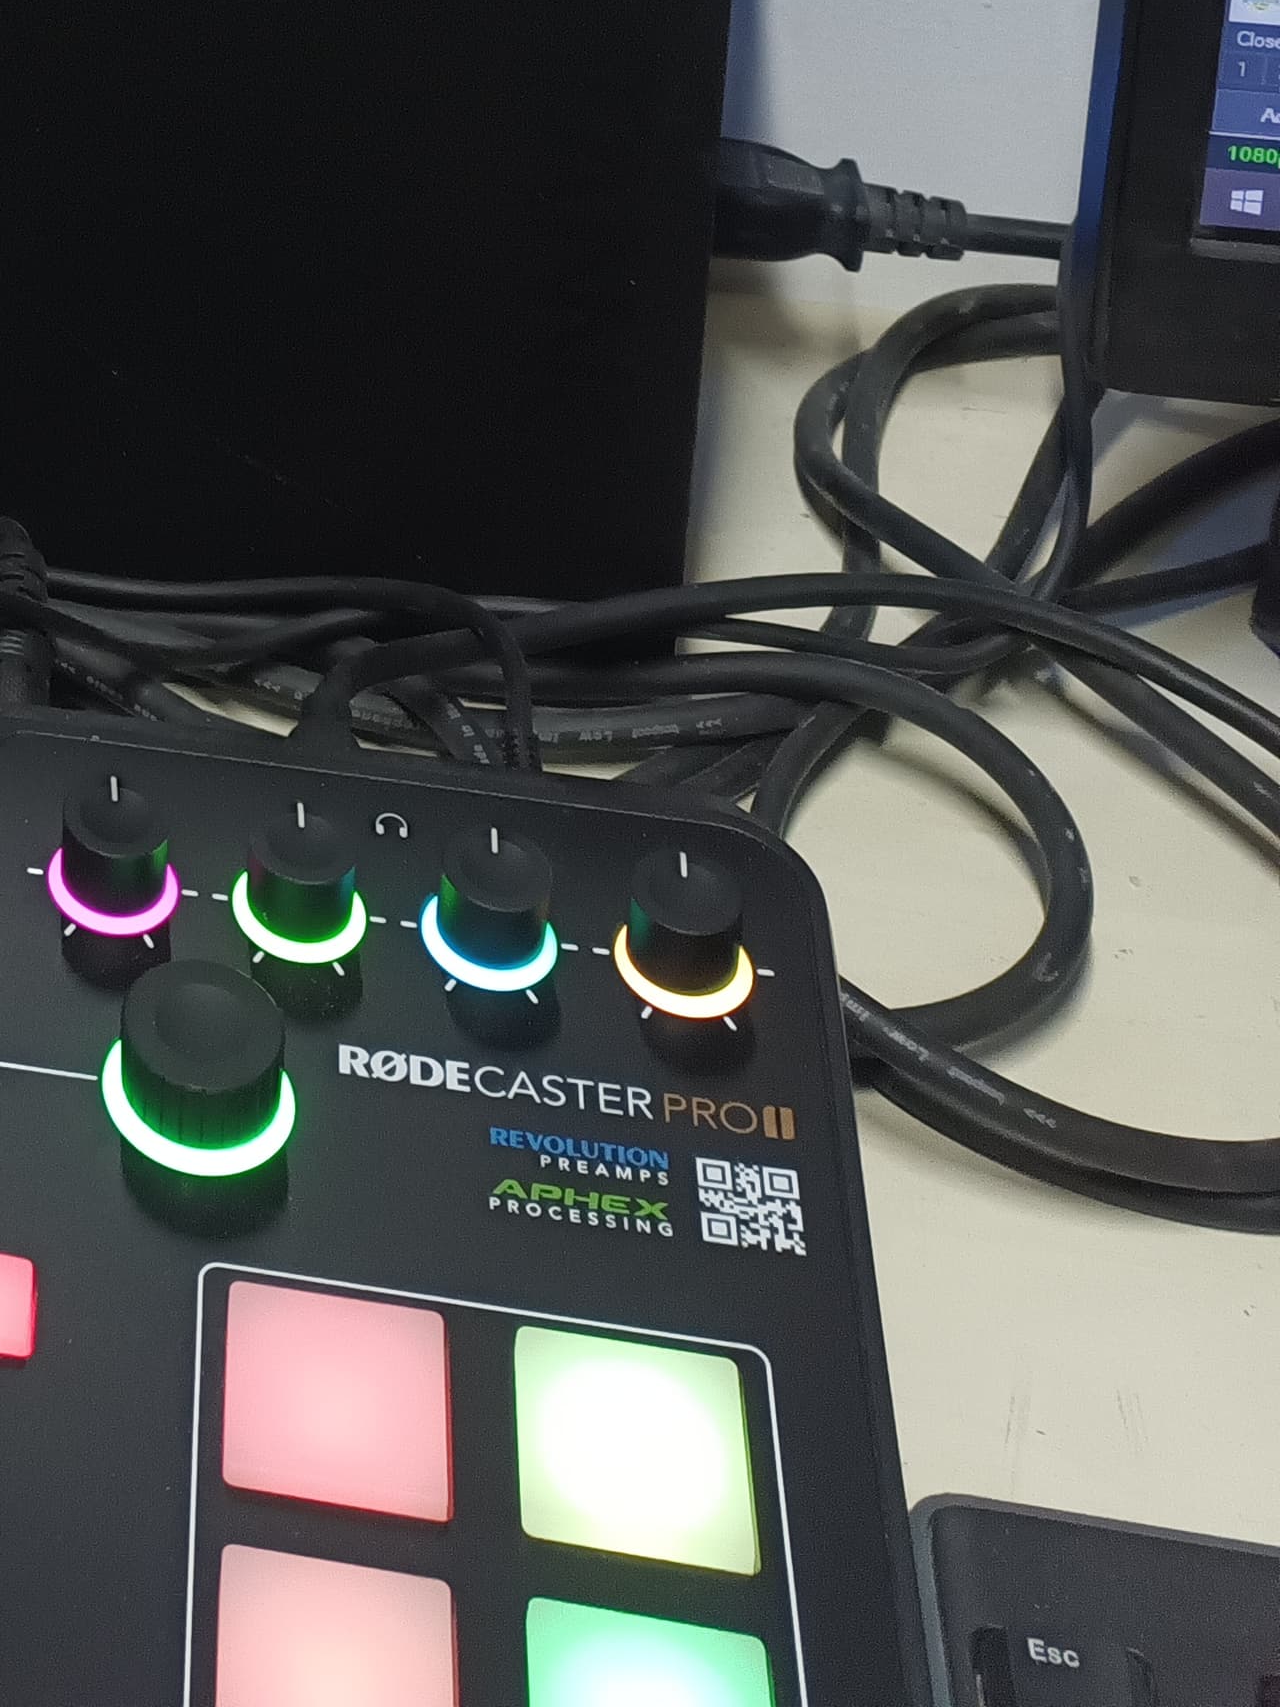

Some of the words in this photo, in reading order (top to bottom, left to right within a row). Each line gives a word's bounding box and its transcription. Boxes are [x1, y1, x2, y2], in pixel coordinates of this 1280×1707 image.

[488, 1125, 670, 1171] REVOLUTION
[539, 1153, 671, 1188] PREAMPS
[487, 1196, 675, 1239] PROCESSING
[491, 1177, 670, 1221] APHEX
[1026, 1636, 1081, 1669] Esc
